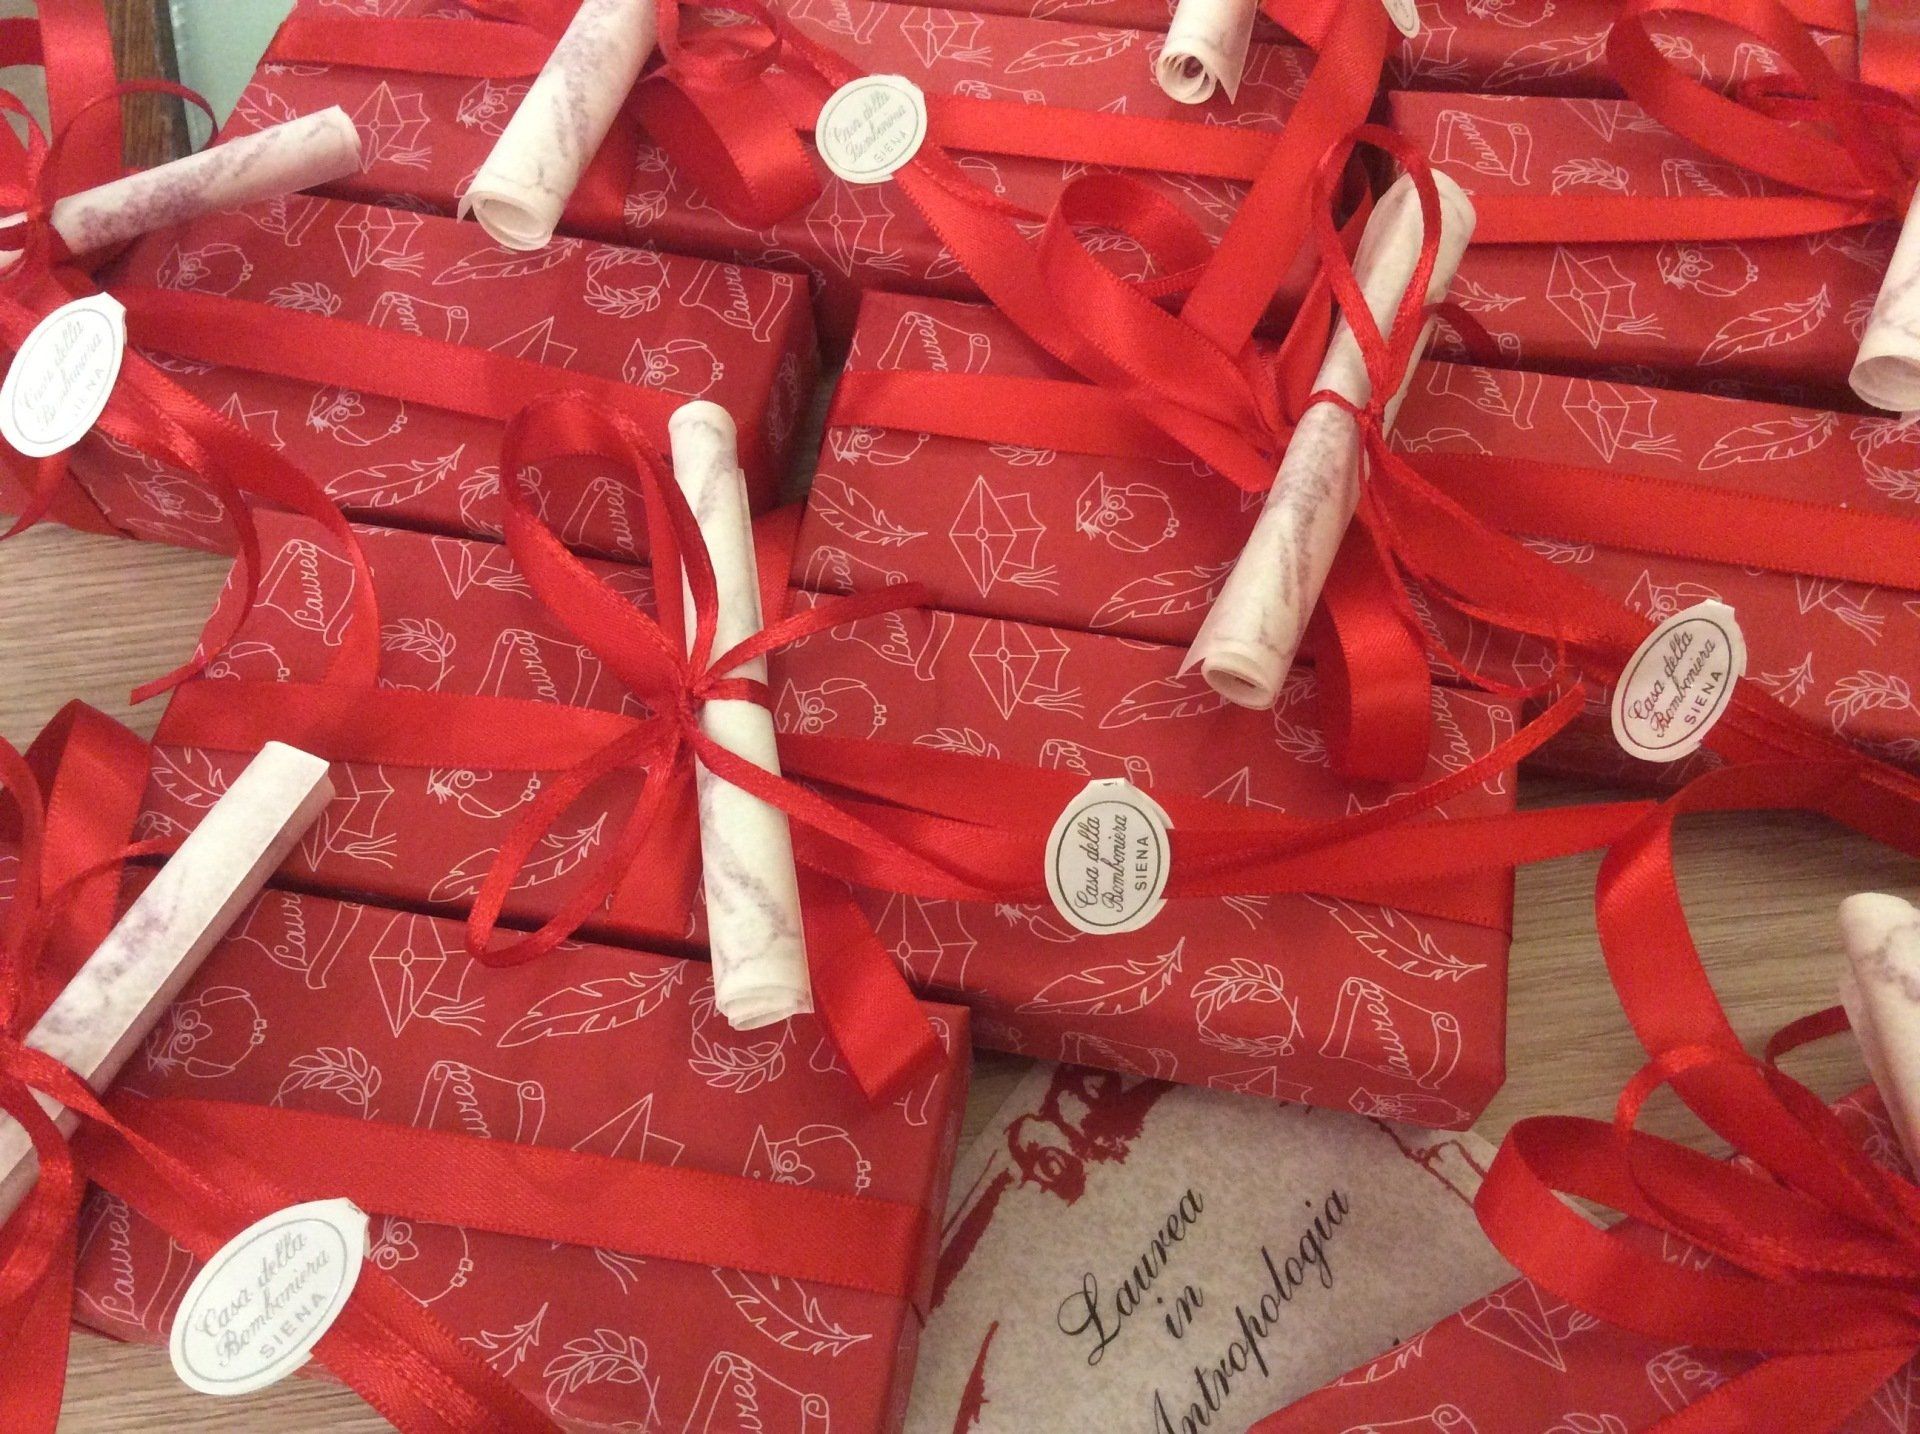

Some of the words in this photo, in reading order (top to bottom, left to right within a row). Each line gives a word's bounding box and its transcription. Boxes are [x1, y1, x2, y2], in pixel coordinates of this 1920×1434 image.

[829, 0, 855, 34] Lau
[1451, 112, 1510, 176] Laurea
[261, 193, 287, 235] Lau
[724, 264, 757, 327] Laure
[917, 316, 949, 373] aurea
[295, 543, 326, 627] Laurea
[517, 633, 560, 705] aurea
[881, 612, 914, 662] Lau
[1628, 680, 1664, 720] Casa
[1664, 631, 1693, 678] della
[1650, 638, 1716, 738] Bomboniera
[1684, 671, 1723, 725] SIENA
[1078, 816, 1100, 862] della
[1101, 815, 1127, 912] Bomboniera
[1135, 836, 1149, 891] SIENA
[1074, 866, 1099, 908] Casa
[274, 892, 308, 966] Laur
[1374, 982, 1418, 1080] Laurea
[101, 1199, 137, 1321] Laurea
[195, 1287, 252, 1337] Casa
[257, 1232, 305, 1287] della
[1057, 1188, 1204, 1366] Laurea
[215, 1250, 329, 1367] Bomboniera
[260, 1293, 326, 1358] SIENA
[1157, 1285, 1204, 1340] in
